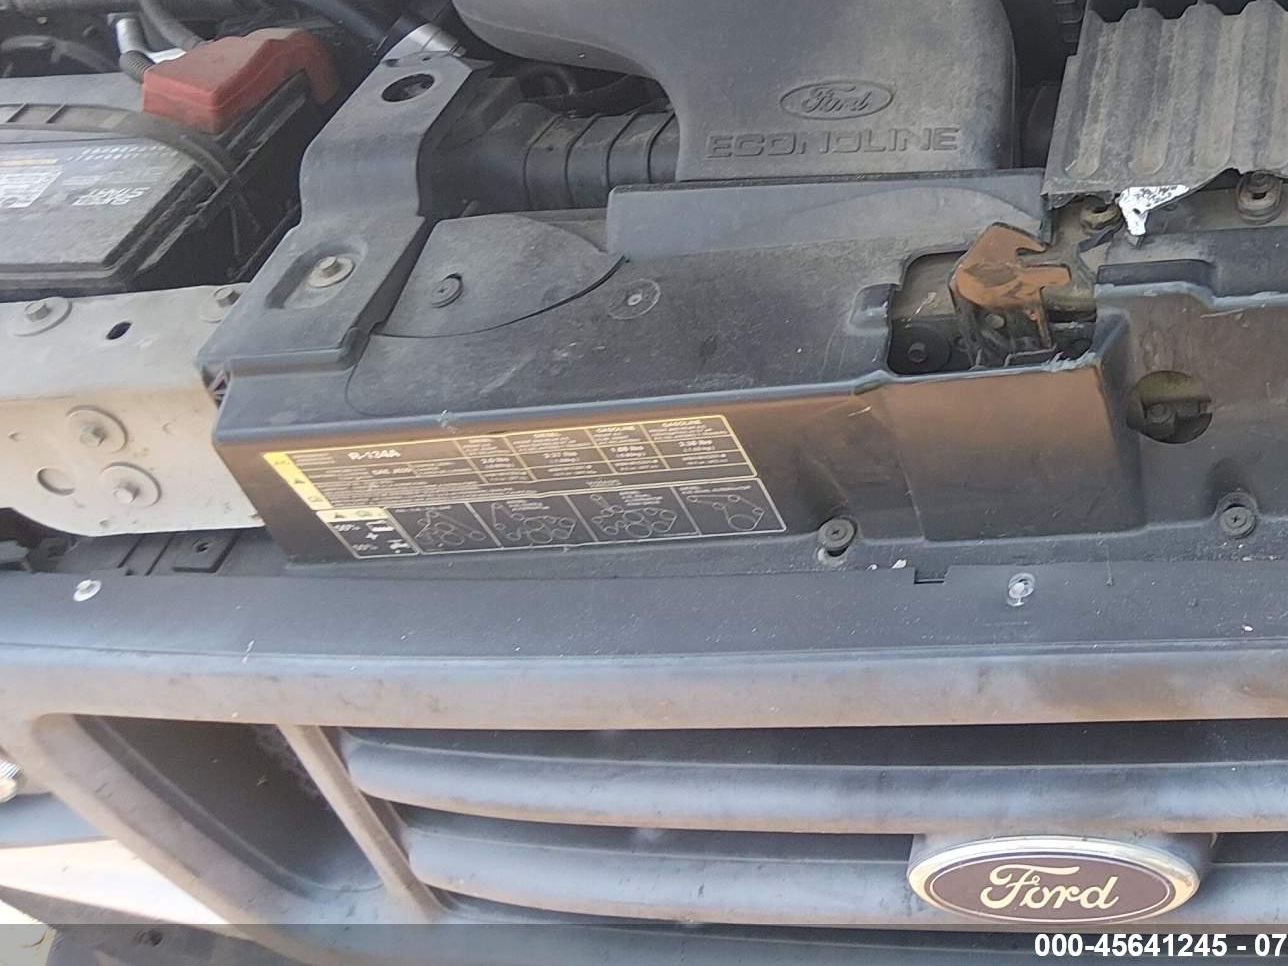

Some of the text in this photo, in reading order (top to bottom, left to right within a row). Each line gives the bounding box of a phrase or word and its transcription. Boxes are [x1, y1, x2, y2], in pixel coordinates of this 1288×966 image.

[800, 85, 874, 114] Ford
[705, 126, 962, 158] ECONOLINE
[980, 863, 1120, 909] Ford
